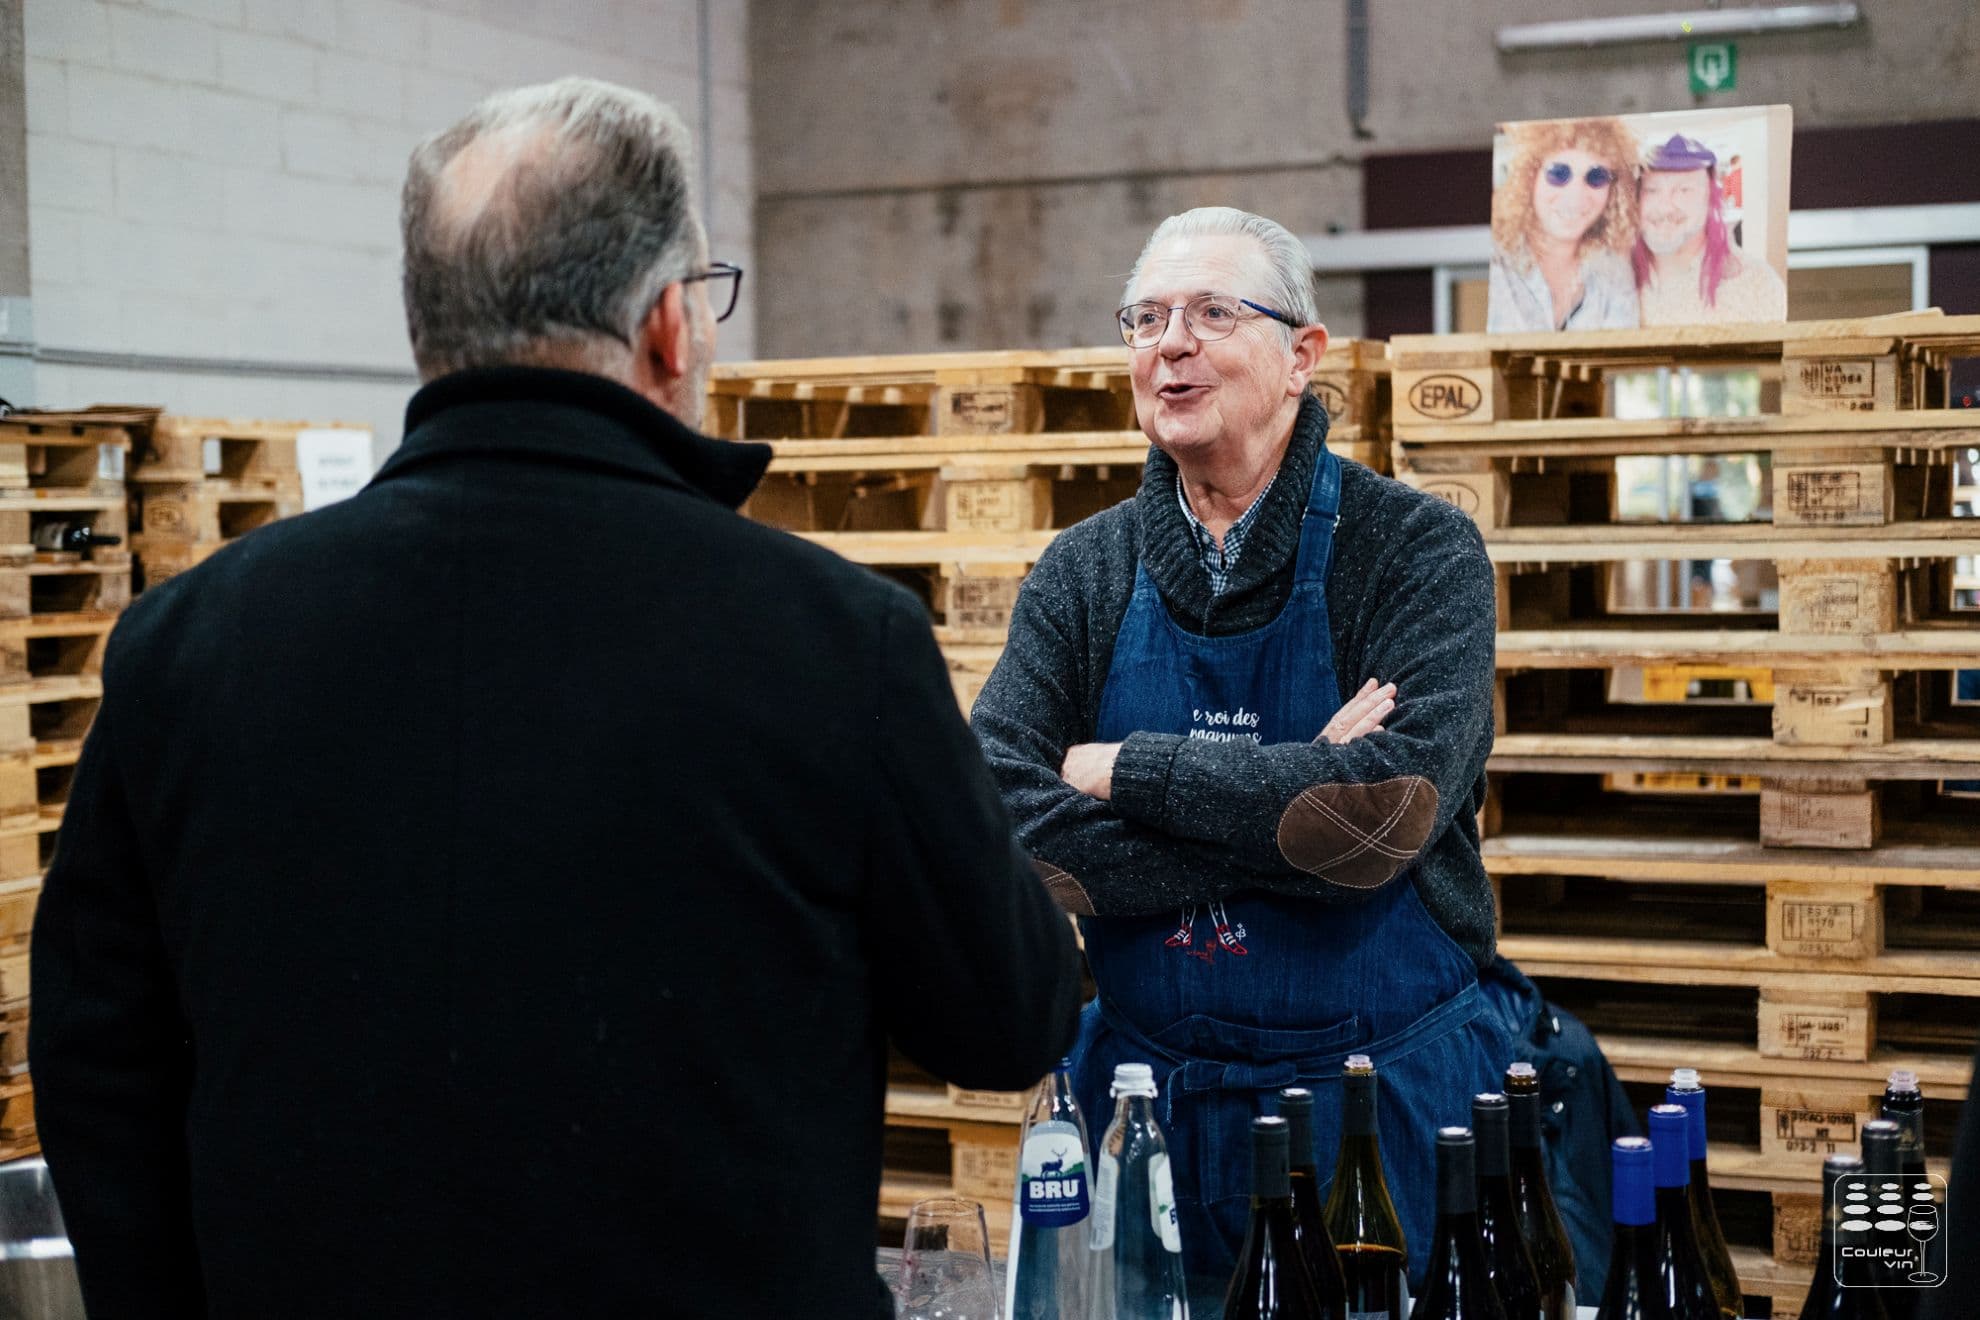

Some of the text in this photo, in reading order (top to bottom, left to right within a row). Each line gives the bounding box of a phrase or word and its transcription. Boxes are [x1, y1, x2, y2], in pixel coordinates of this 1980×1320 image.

[1420, 385, 1472, 409] EPAL
[1205, 710, 1230, 726] roi
[1232, 706, 1260, 728] des
[1029, 1179, 1081, 1199] BRU
